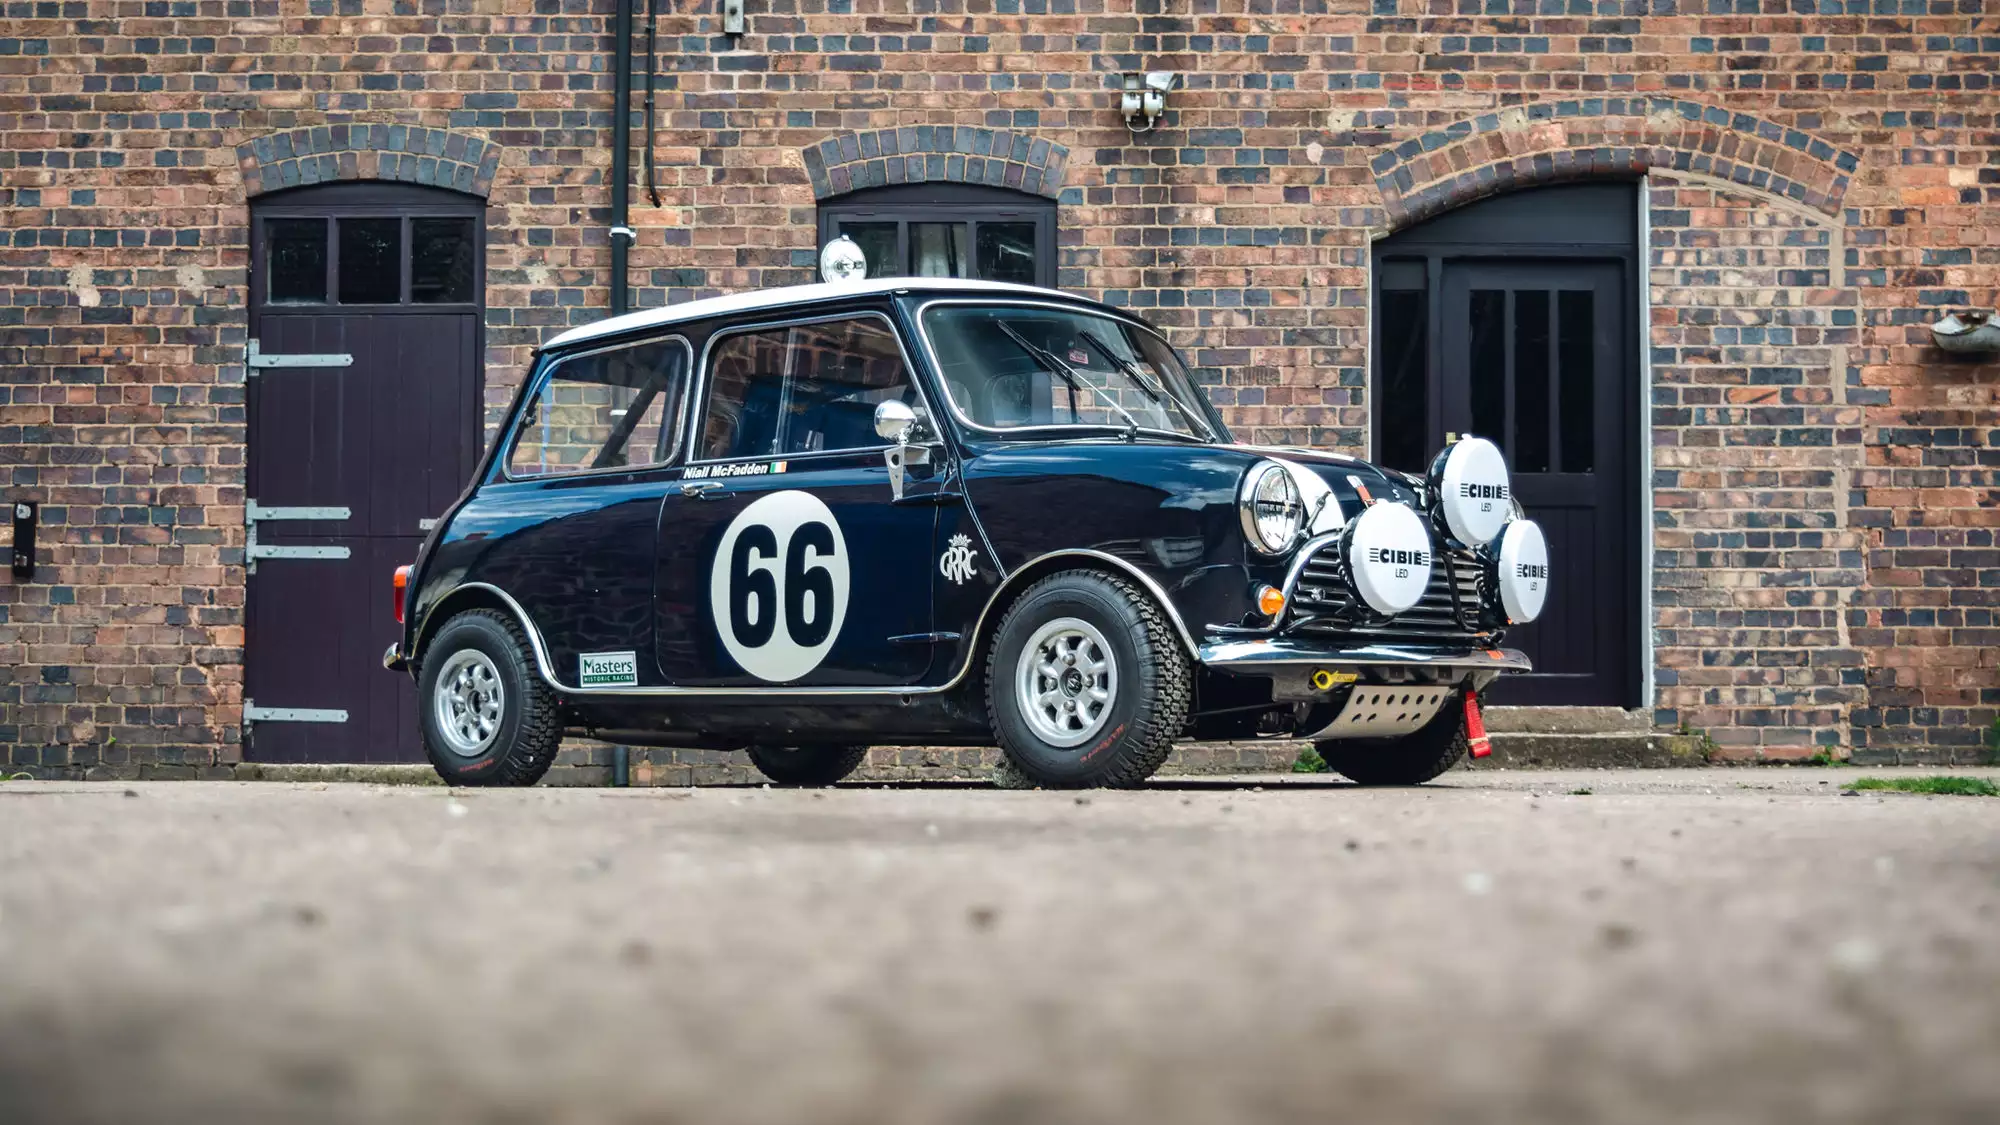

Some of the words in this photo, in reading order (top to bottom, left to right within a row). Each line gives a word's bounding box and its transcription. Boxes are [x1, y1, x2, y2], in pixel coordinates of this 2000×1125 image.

[683, 465, 710, 479] Niall
[711, 463, 768, 478] McFadden
[1480, 502, 1492, 512] LED
[1395, 568, 1409, 578] LED
[729, 520, 836, 649] 66
[583, 659, 633, 674] Masters
